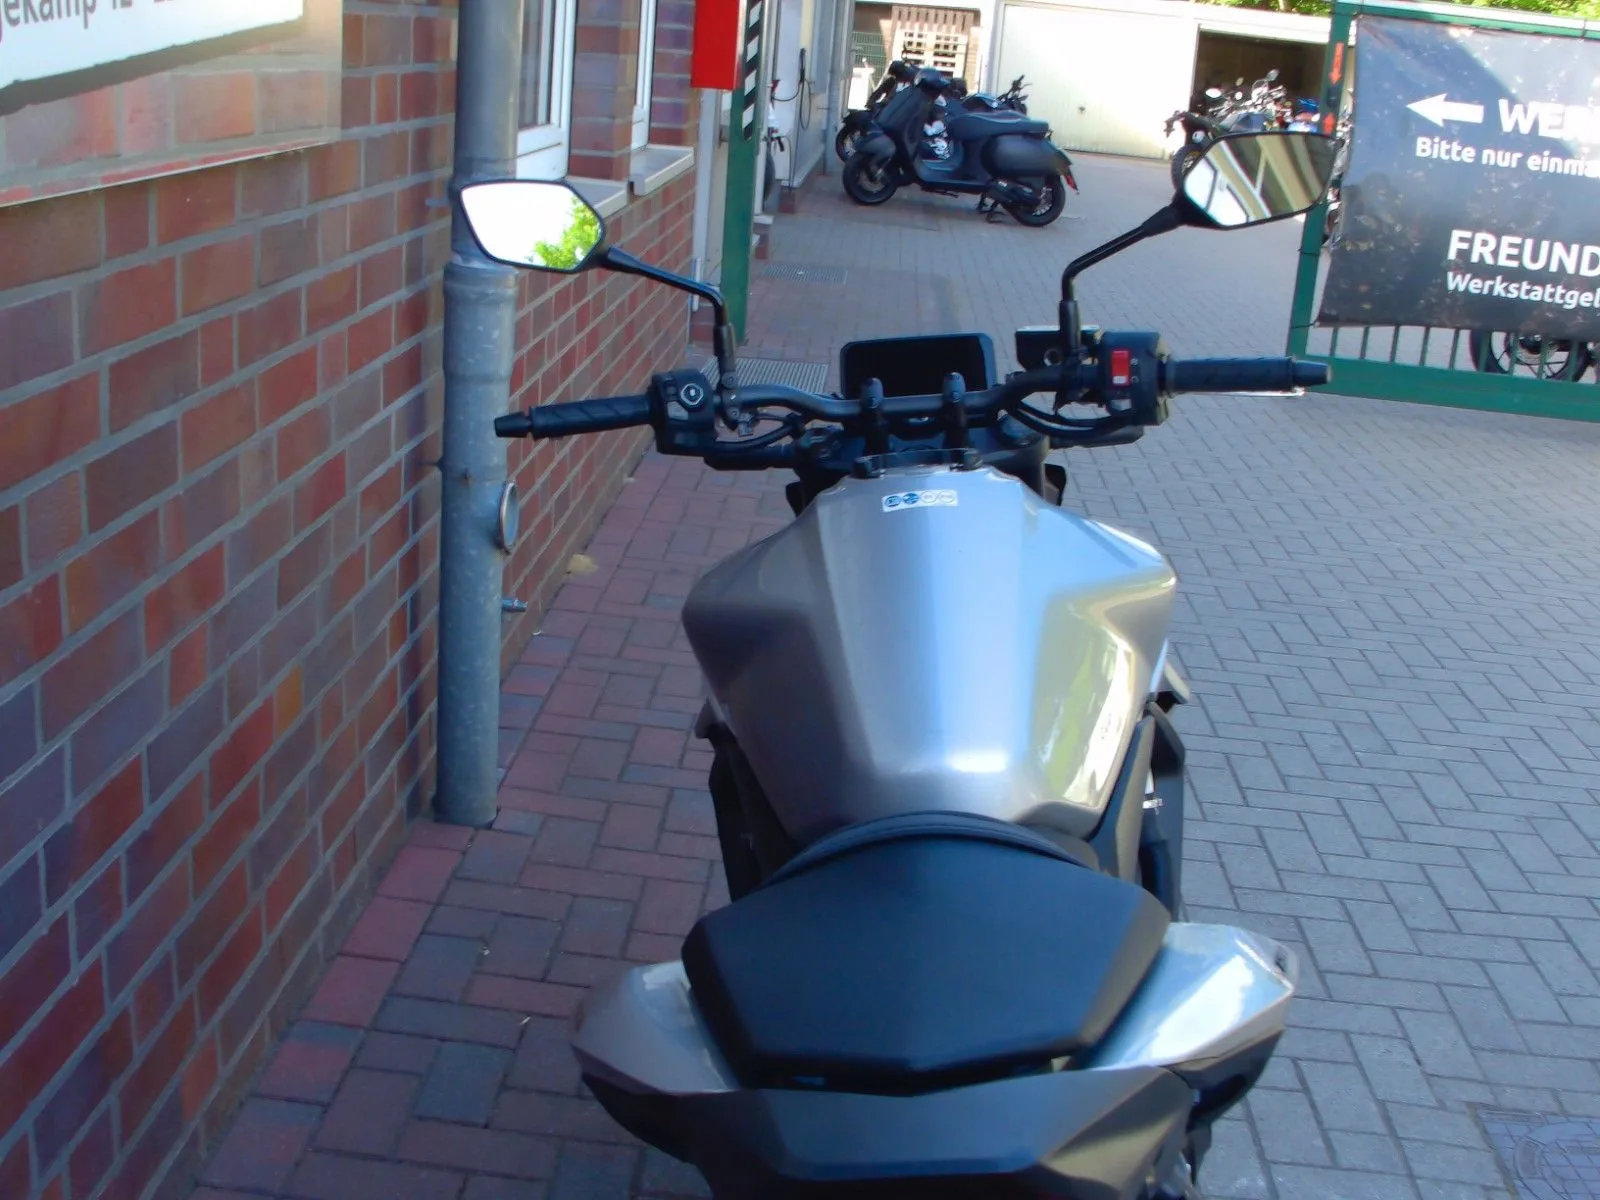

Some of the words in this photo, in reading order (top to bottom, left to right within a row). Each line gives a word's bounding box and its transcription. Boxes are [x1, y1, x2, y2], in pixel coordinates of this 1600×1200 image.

[0, 0, 97, 42] ekamp
[1416, 136, 1476, 163] Bitte
[1482, 149, 1524, 168] nur
[1447, 229, 1600, 277] FREUND
